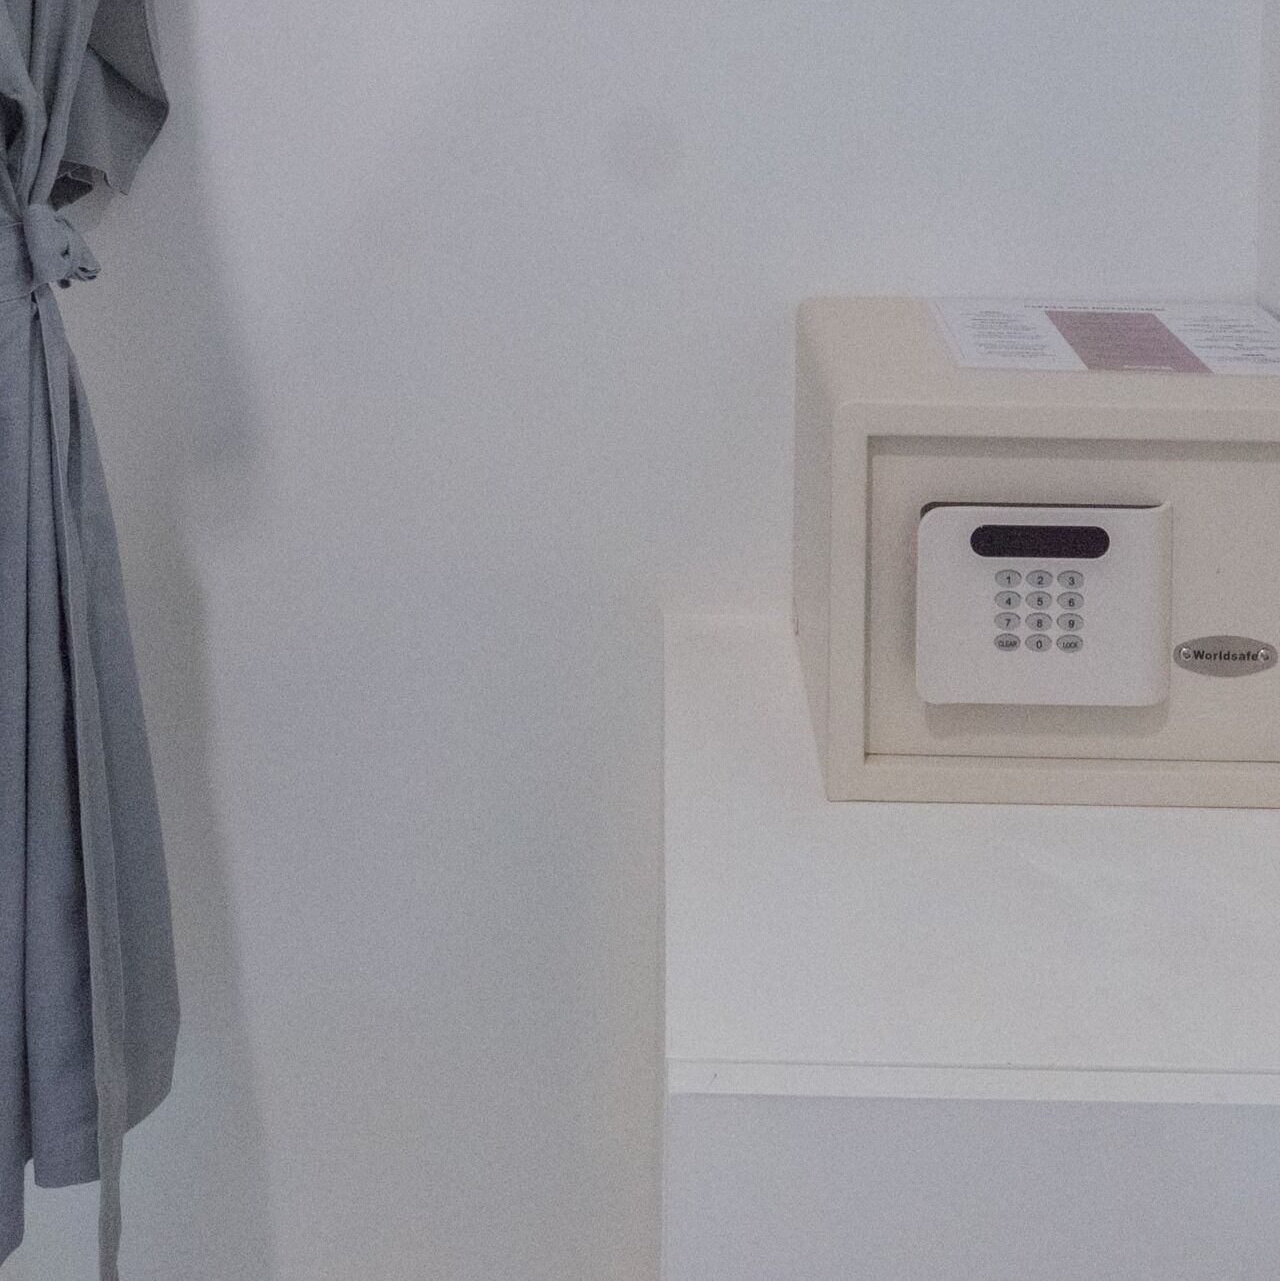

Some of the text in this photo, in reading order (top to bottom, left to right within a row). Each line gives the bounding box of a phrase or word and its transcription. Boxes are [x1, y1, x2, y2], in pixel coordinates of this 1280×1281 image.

[1037, 575, 1044, 586] 2
[1068, 576, 1075, 586] 3
[1036, 597, 1043, 607] 5
[1068, 598, 1075, 608] 6
[1036, 619, 1043, 629] 8
[1068, 619, 1075, 629] 9
[998, 639, 1078, 649] CLEAR 0 LOCK
[1193, 649, 1259, 662] Worldsafe
